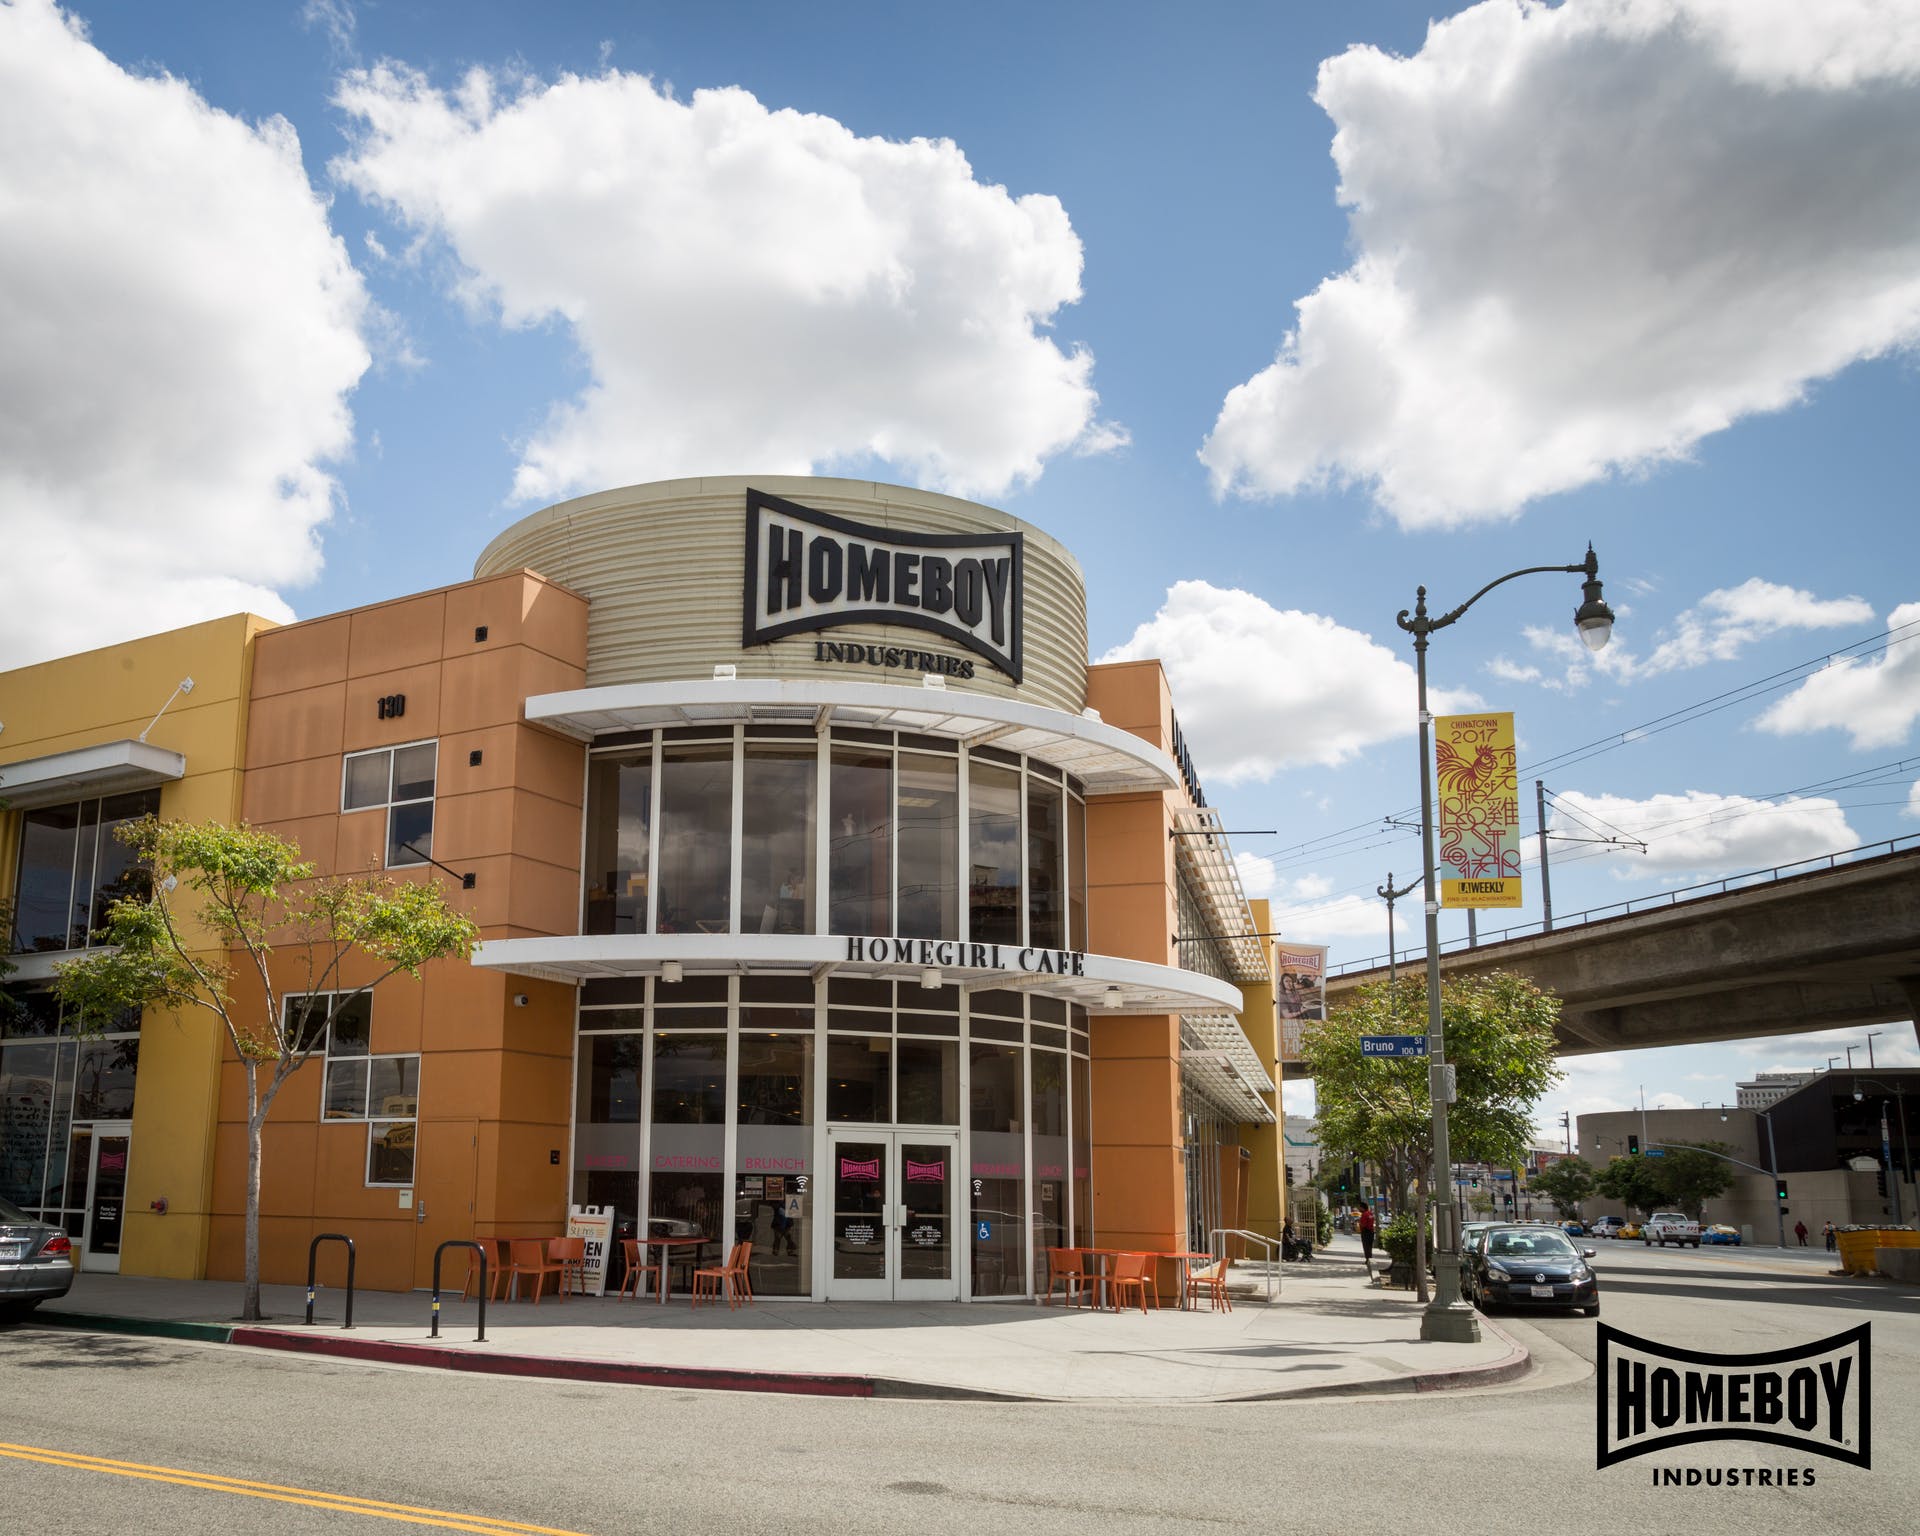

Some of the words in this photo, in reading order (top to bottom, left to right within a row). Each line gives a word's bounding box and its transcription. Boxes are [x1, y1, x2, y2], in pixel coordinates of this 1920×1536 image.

[767, 523, 1010, 647] HOMEBOY
[814, 641, 975, 680] INDUSTRIES
[377, 694, 405, 720] 130
[1450, 719, 1498, 729] CHINATOWN
[1451, 728, 1498, 744] 2017
[846, 937, 1005, 970] HOMEGIRL
[1018, 948, 1085, 977] CAFE
[1282, 954, 1318, 968] HOMEGIRL
[1363, 1040, 1394, 1052] Bruno
[1414, 1036, 1423, 1045] St
[1401, 1047, 1414, 1055] 100
[655, 1155, 720, 1168] CATERING
[745, 1157, 804, 1170] BRUNCH
[843, 1163, 876, 1175] HOMEGIRL
